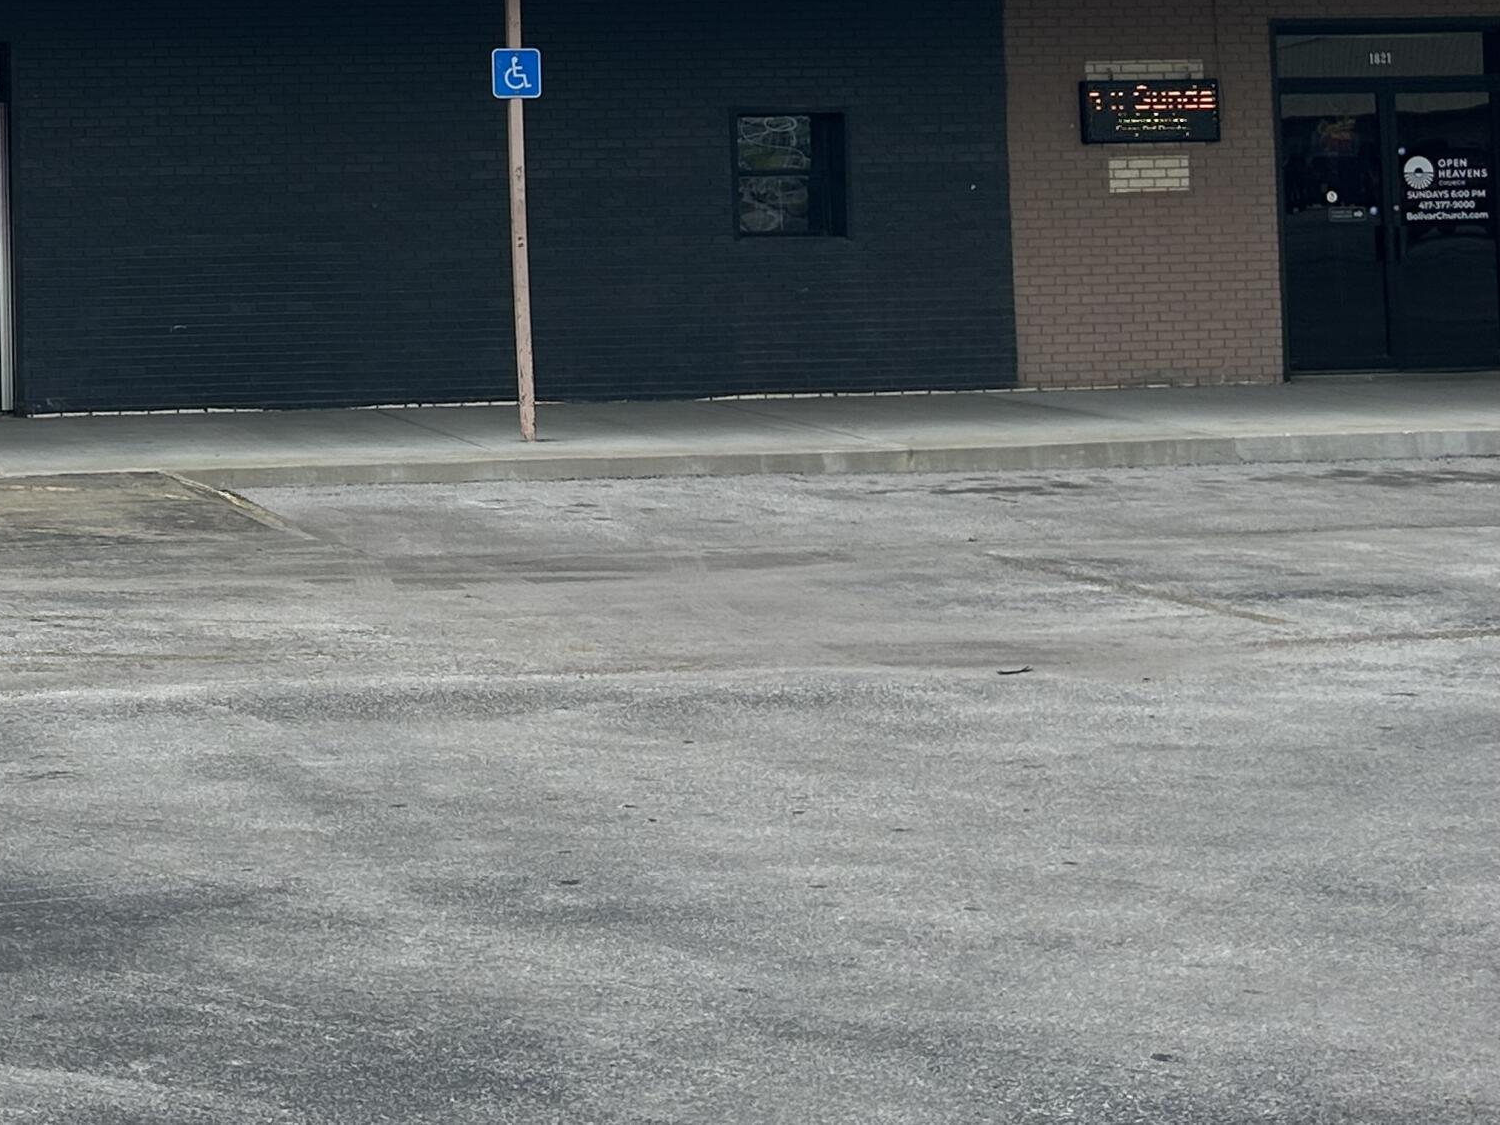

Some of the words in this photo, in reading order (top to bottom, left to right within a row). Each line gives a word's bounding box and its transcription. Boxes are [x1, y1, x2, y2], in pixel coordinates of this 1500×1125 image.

[1437, 158, 1468, 168] OPEN
[1438, 168, 1488, 179] HEAVENS
[1406, 190, 1450, 199] SUNDAYS
[1450, 189, 1470, 198] 6:00
[1471, 189, 1486, 198] PM
